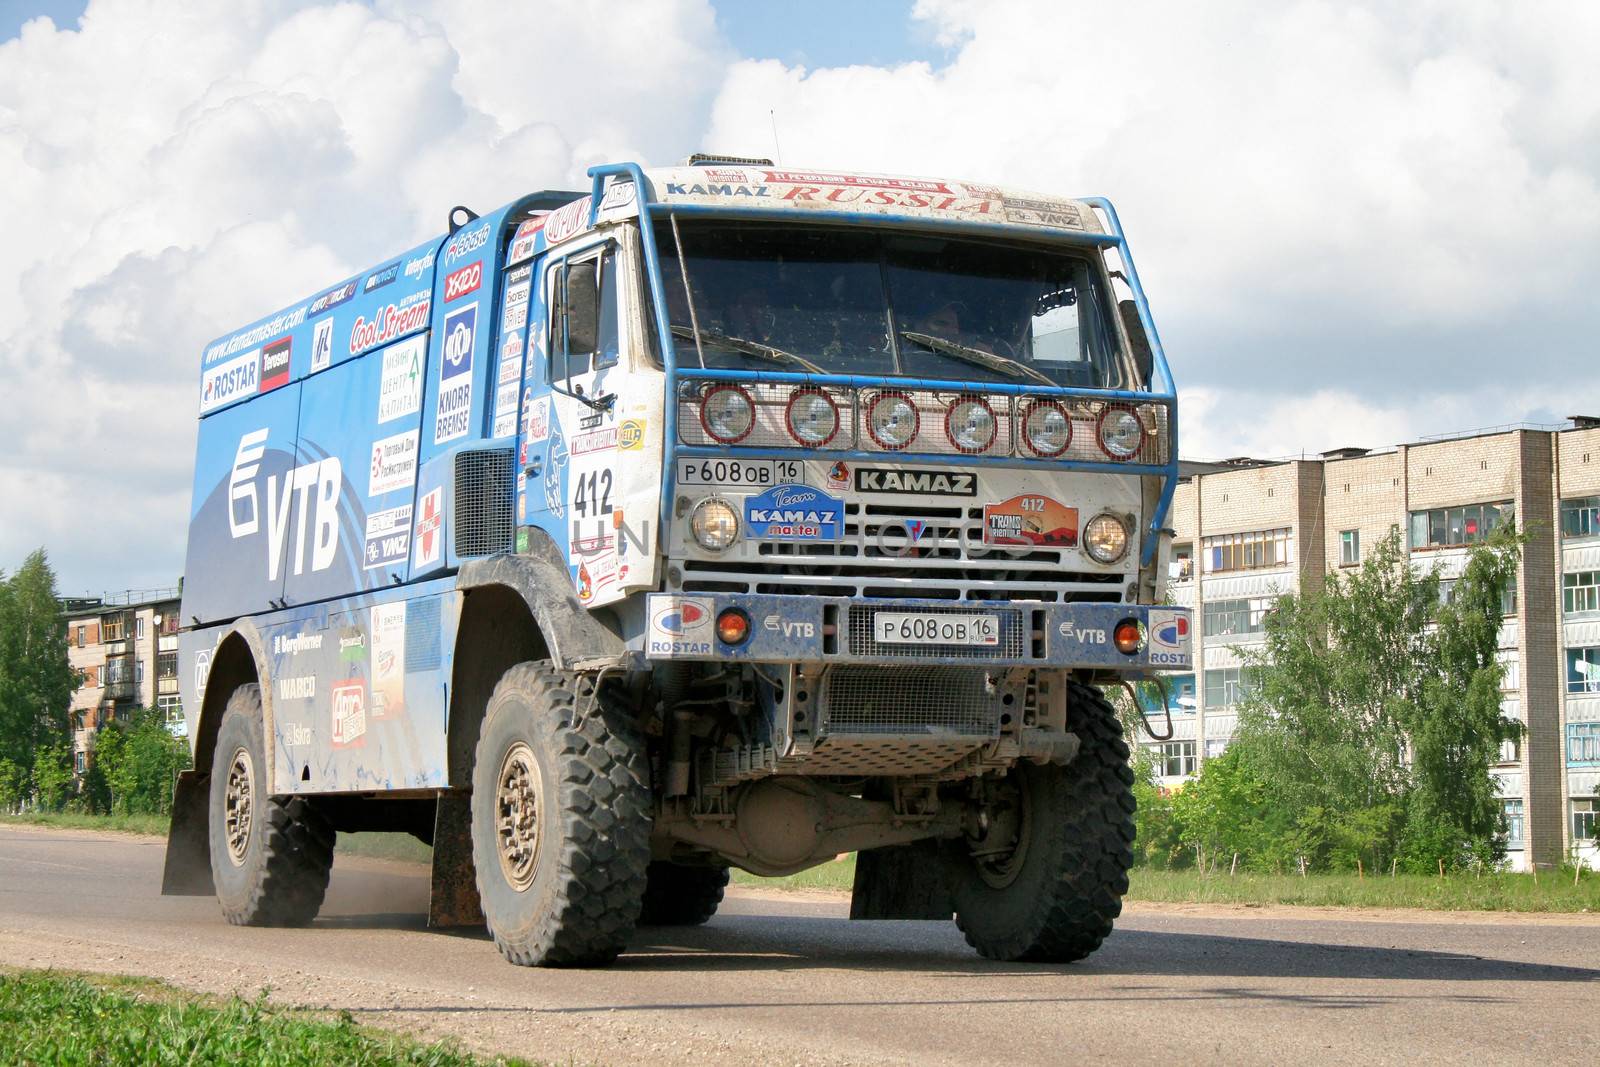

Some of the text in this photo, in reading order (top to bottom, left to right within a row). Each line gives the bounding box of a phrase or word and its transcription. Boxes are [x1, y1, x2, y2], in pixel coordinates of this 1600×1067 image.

[666, 183, 772, 198] KAMAZ
[783, 186, 990, 213] RUSSIA
[350, 302, 431, 354] Cool Stream
[263, 350, 290, 373] Teroson
[214, 361, 257, 401] ROSTAR
[439, 384, 471, 415] KNORR
[436, 410, 469, 440] BREMSE
[778, 462, 797, 478] 16
[575, 468, 613, 518] 412
[861, 471, 973, 493] KAMAZ
[773, 488, 817, 508] Team
[1020, 497, 1046, 512] 412
[267, 457, 341, 581] VTB
[751, 509, 837, 526] KAMAZ
[989, 514, 1022, 529] TRANS
[768, 525, 818, 537] master
[382, 535, 408, 557] YMZ
[782, 622, 815, 638] VTB
[971, 618, 990, 635] 16
[1075, 629, 1107, 644] VTB
[652, 641, 711, 654] ROSTAR
[280, 676, 316, 701] WABCO
[292, 724, 311, 746] Iskra
